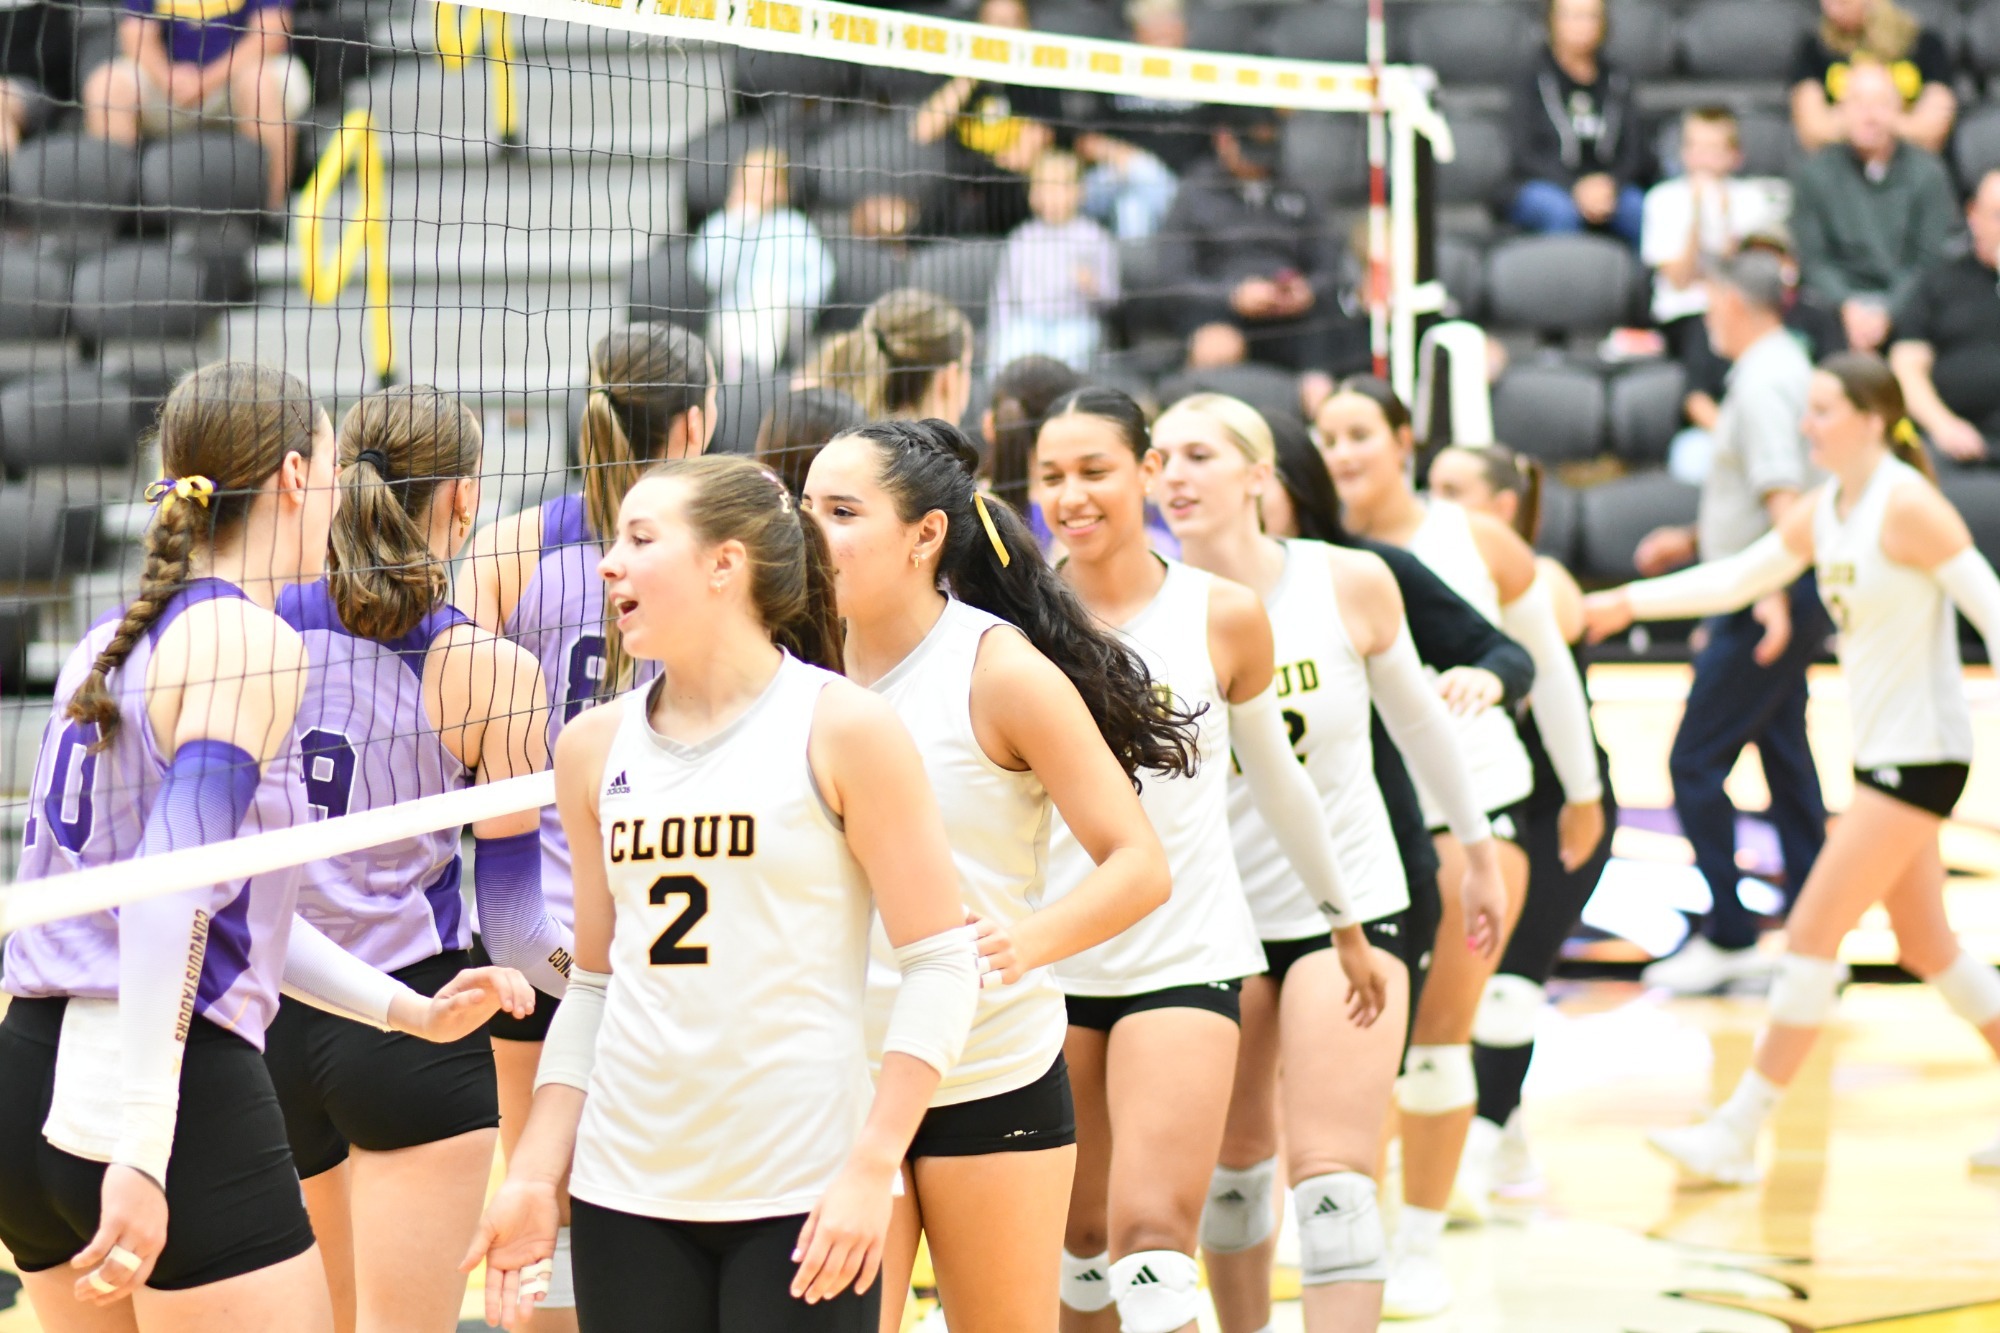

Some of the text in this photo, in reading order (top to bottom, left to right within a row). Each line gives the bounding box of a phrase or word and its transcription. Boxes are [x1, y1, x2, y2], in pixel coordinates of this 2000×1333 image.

[299, 727, 357, 819] 9
[606, 786, 630, 796] adidas
[610, 814, 755, 863] CLOUD
[649, 875, 708, 965] 2
[175, 909, 208, 1043] CONQUISTADORS
